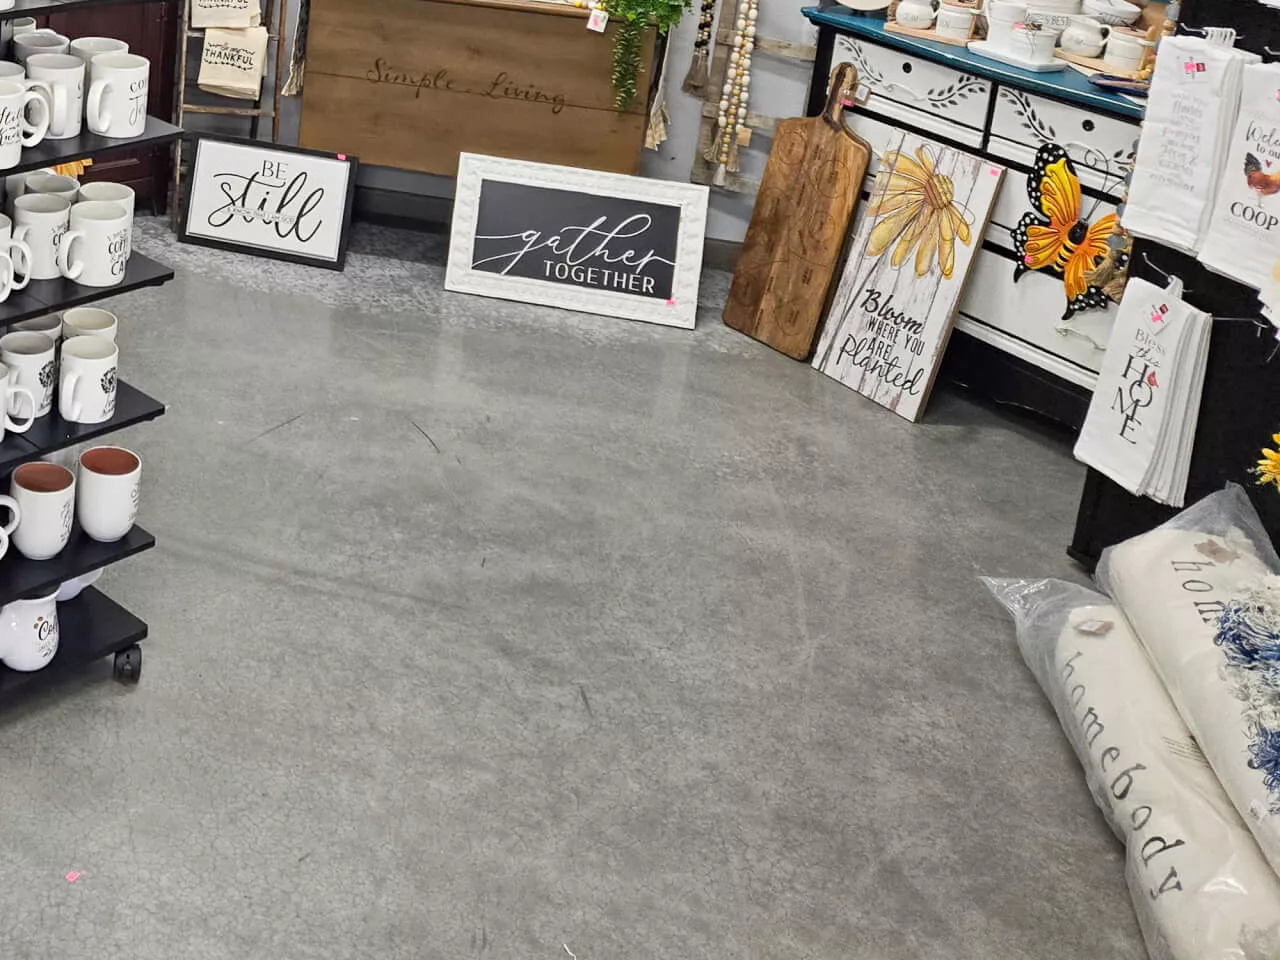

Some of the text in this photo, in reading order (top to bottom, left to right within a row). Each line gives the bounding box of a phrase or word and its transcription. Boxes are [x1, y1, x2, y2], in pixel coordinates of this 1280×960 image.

[204, 48, 254, 66] THANKFUL
[367, 57, 569, 114] Simple Living
[262, 160, 288, 180] BE
[208, 171, 324, 242] still
[1230, 201, 1279, 231] COOP
[474, 214, 677, 276] gather
[544, 260, 656, 294] TOGETHER
[860, 289, 923, 335] Bloom
[866, 337, 892, 361] ARE
[867, 316, 925, 356] WHERE YOU
[836, 333, 925, 395] Planted
[1111, 354, 1153, 444] HOME
[1061, 650, 1185, 901] homebody
